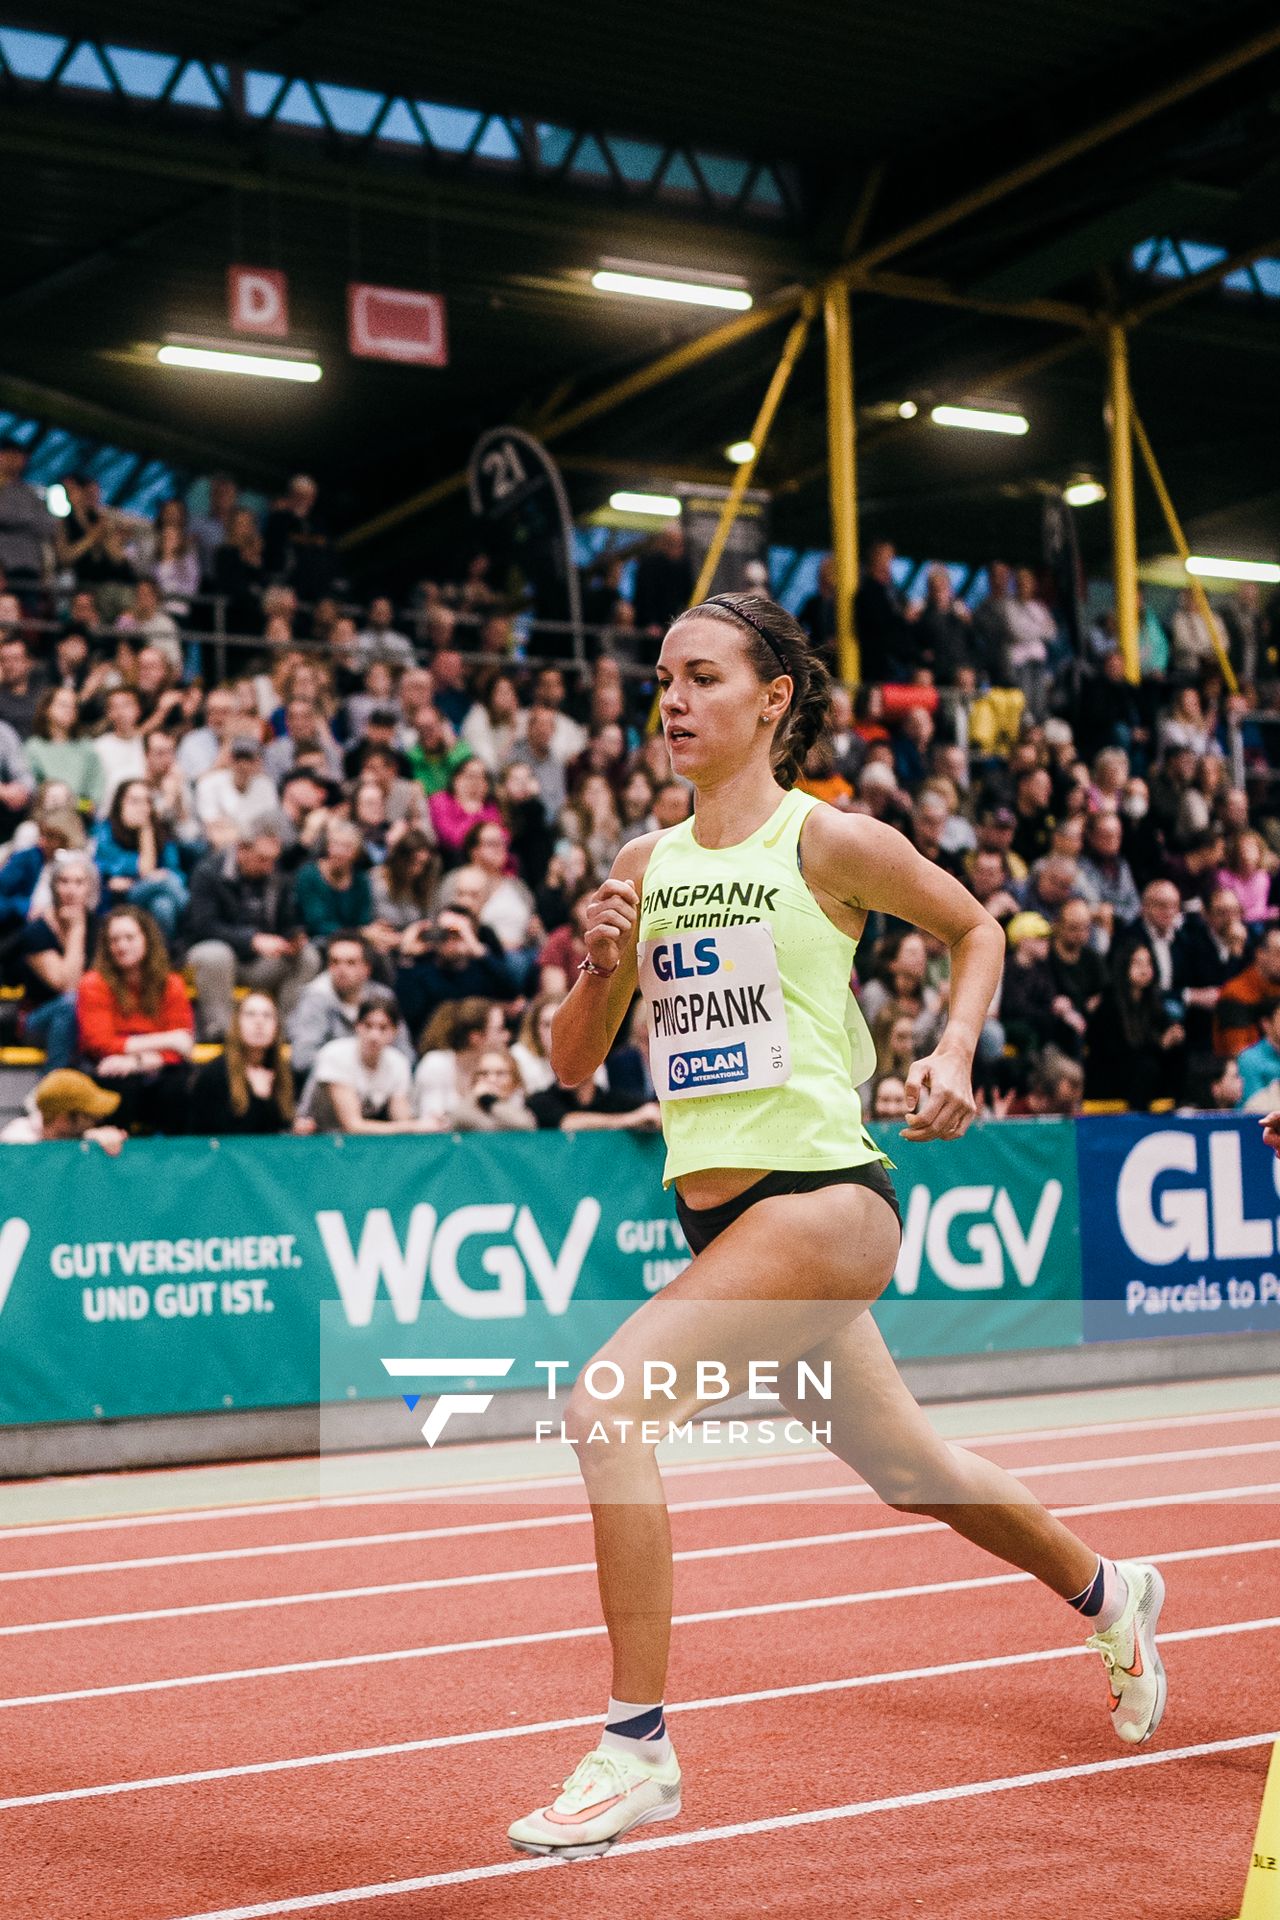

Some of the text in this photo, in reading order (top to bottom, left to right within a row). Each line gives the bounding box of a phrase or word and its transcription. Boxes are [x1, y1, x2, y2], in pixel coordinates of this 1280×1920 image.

[239, 274, 280, 322] D
[643, 882, 780, 915] PINGPANK
[652, 984, 772, 1038] PINGPANK
[690, 1051, 744, 1073] PLAN
[692, 1070, 745, 1082] INTERNATIONAL
[770, 1045, 783, 1069] 216
[1116, 1129, 1280, 1266] GL
[50, 1241, 115, 1279] GUT
[115, 1234, 303, 1277] VERSICHERT.
[616, 1219, 668, 1254] GUT
[315, 1196, 601, 1327] WGV
[82, 1278, 275, 1323] UND GUT IST.
[1126, 1276, 1222, 1315] Parcels
[1226, 1276, 1256, 1309] to
